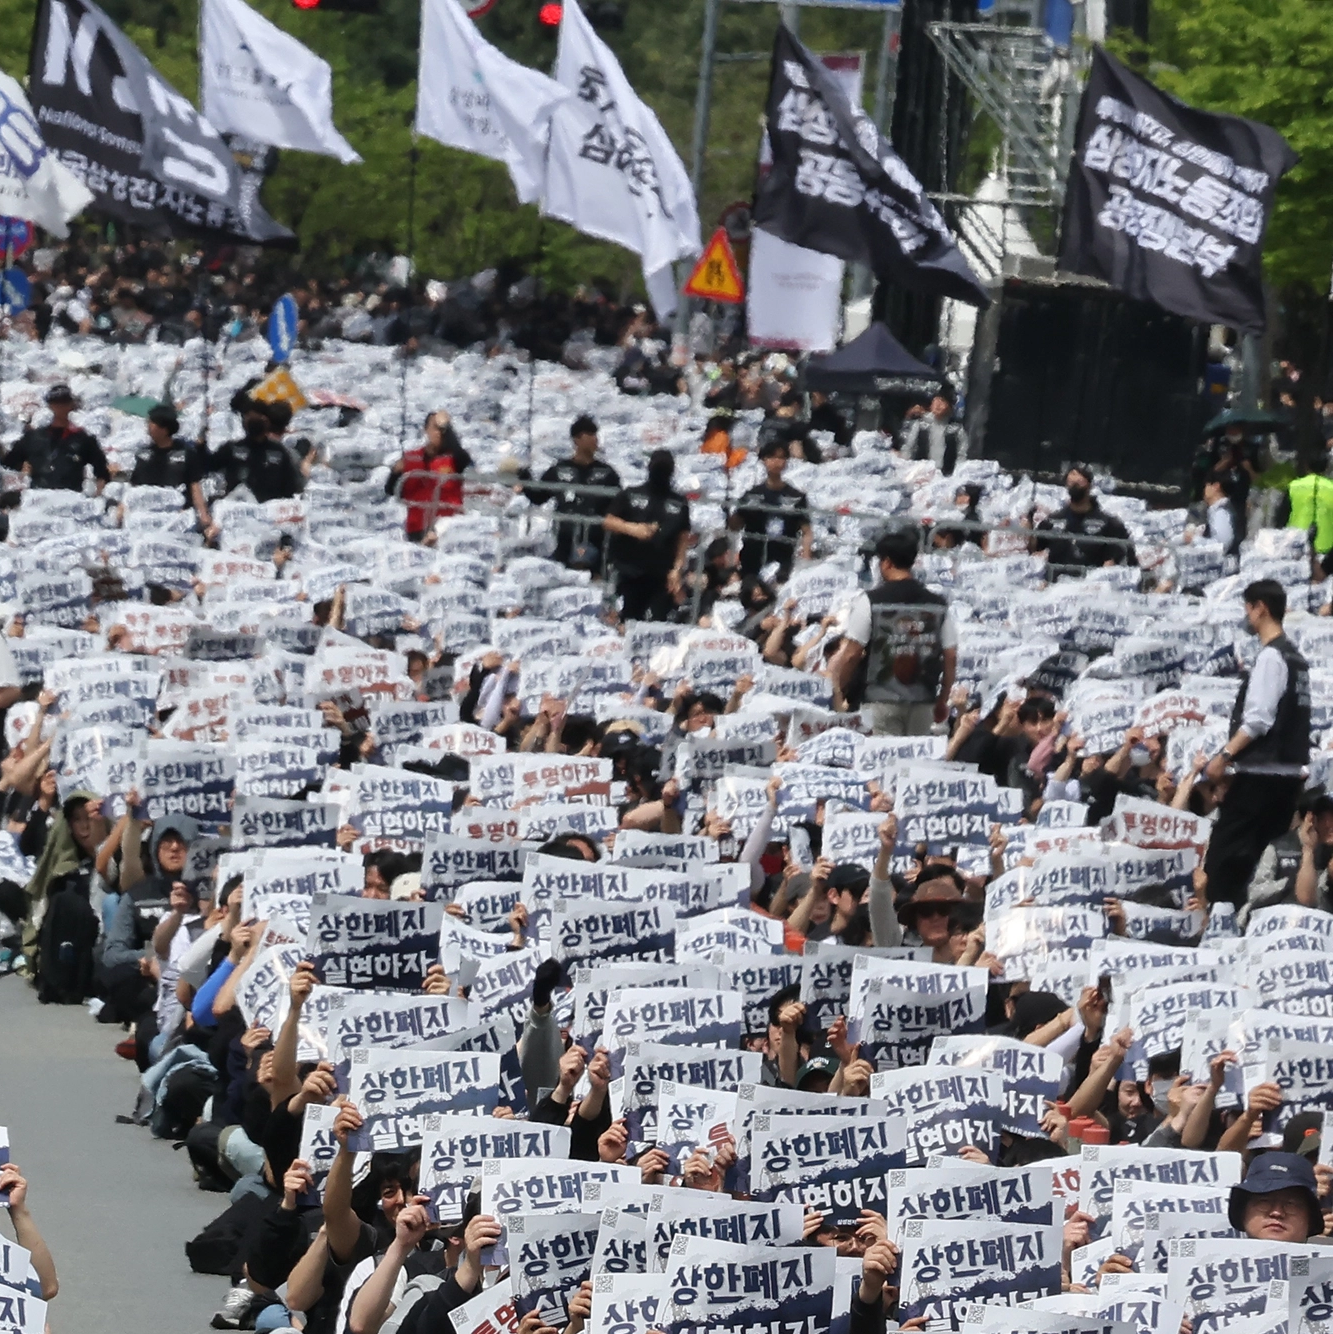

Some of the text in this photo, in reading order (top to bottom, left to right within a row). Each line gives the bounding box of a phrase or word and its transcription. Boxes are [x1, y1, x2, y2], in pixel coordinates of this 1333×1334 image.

[316, 906, 426, 941] 상한폐지
[558, 906, 661, 947] 상한폐지
[322, 951, 433, 985] 실현하자
[336, 1003, 451, 1049] 상한폐지
[611, 993, 725, 1034] 상한폐지
[870, 990, 974, 1034] 상한폐지
[359, 1058, 481, 1102] 상한폐지
[761, 1119, 889, 1173] 상한폐지
[670, 1252, 815, 1305] 상한폐지
[911, 1230, 1046, 1284] 상한폐지
